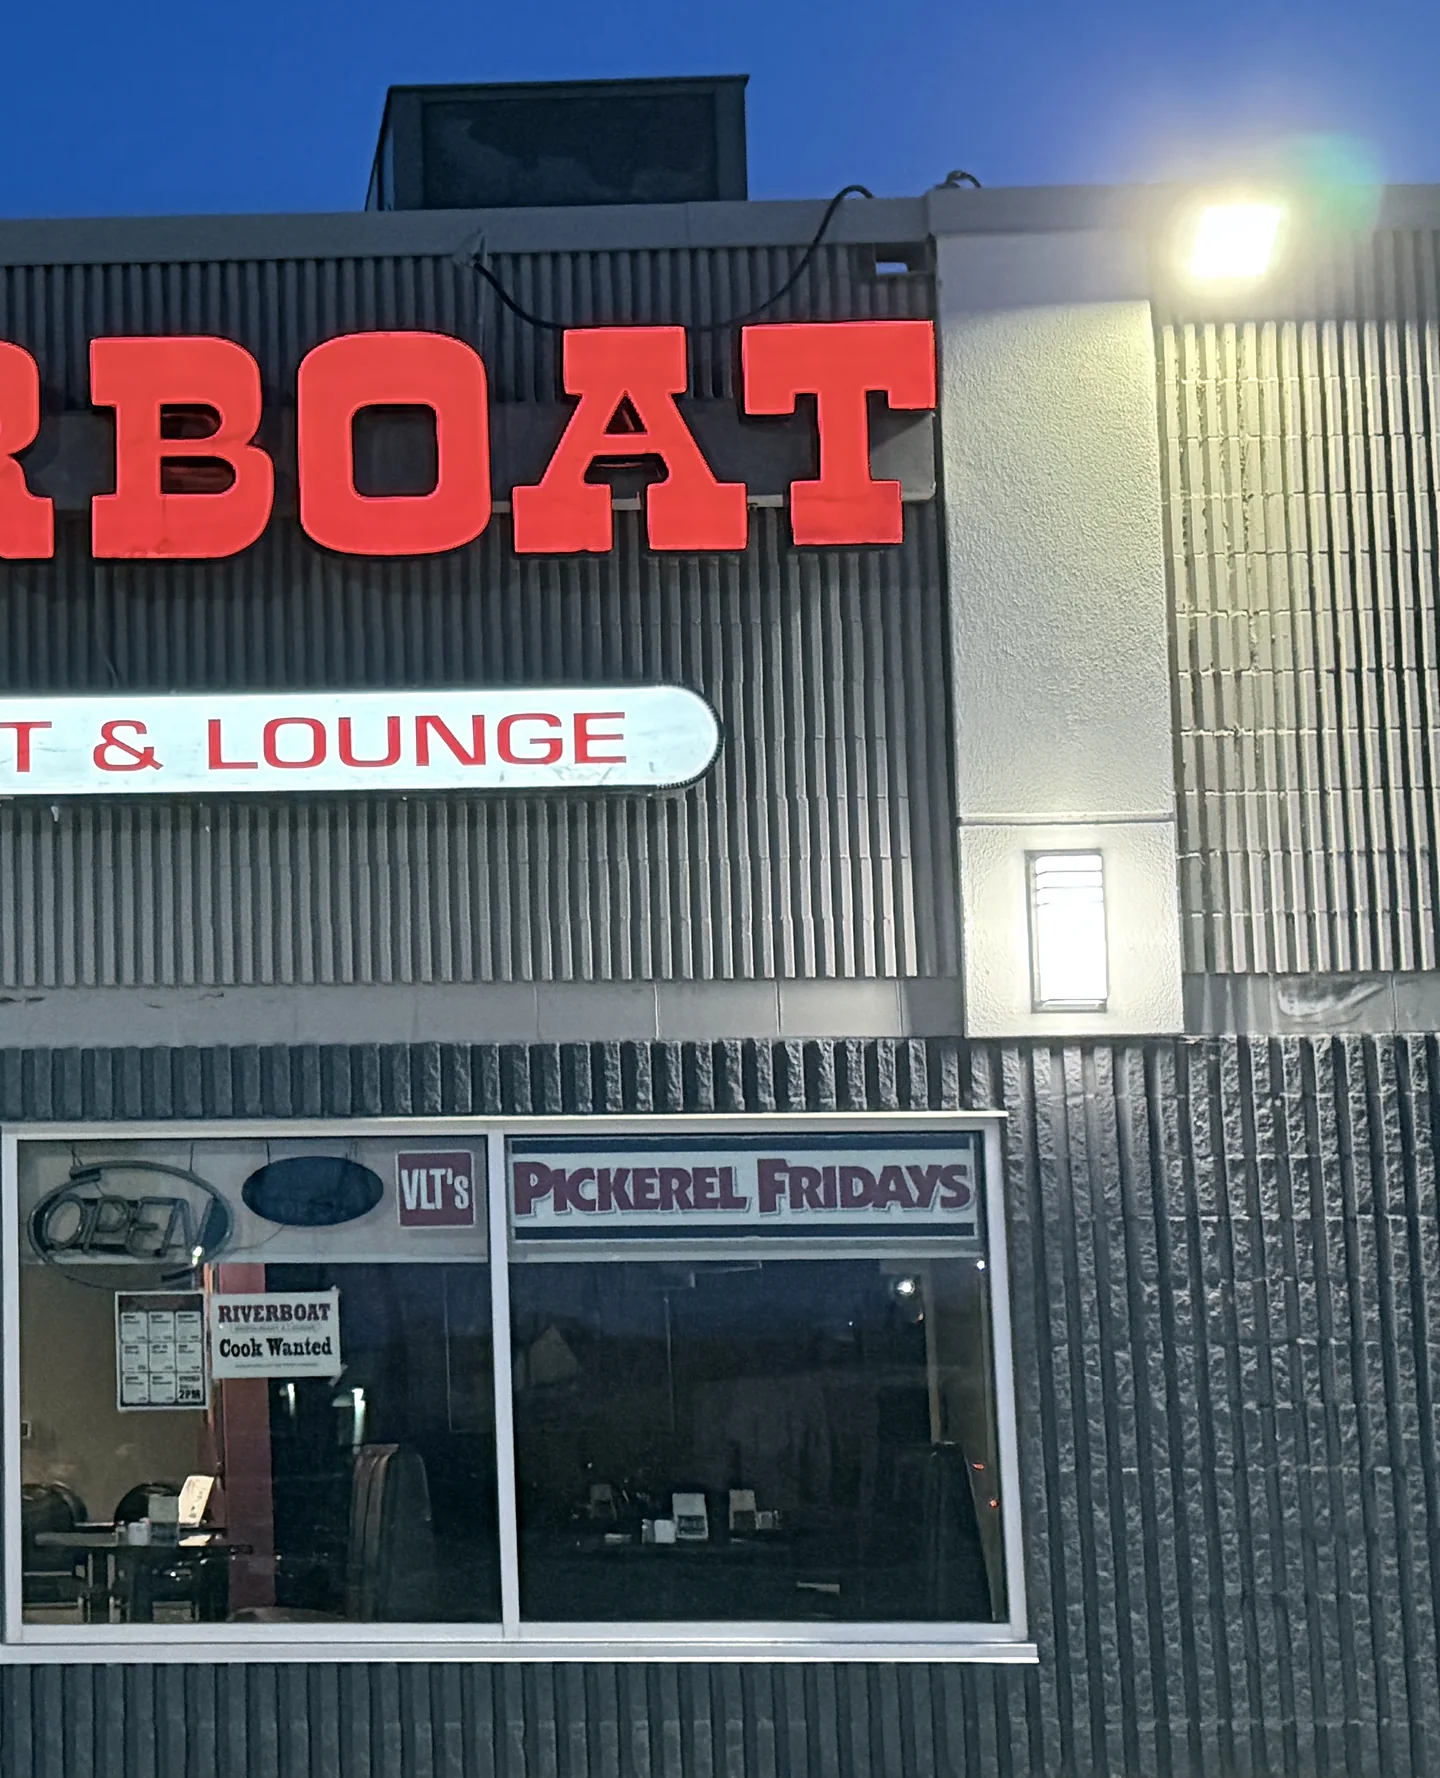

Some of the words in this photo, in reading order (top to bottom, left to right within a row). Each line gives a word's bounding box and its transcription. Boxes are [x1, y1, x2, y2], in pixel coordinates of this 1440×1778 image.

[92, 720, 163, 771] &
[208, 712, 627, 770] LOUNGE
[400, 1167, 470, 1211] VLT's
[512, 1160, 751, 1215] PICKEREL
[757, 1158, 976, 1216] FRIDAYS
[41, 1193, 214, 1259] OPEN
[217, 1303, 331, 1323] RIVERBOAT
[220, 1337, 263, 1358] Cook
[266, 1336, 333, 1357] Wanted
